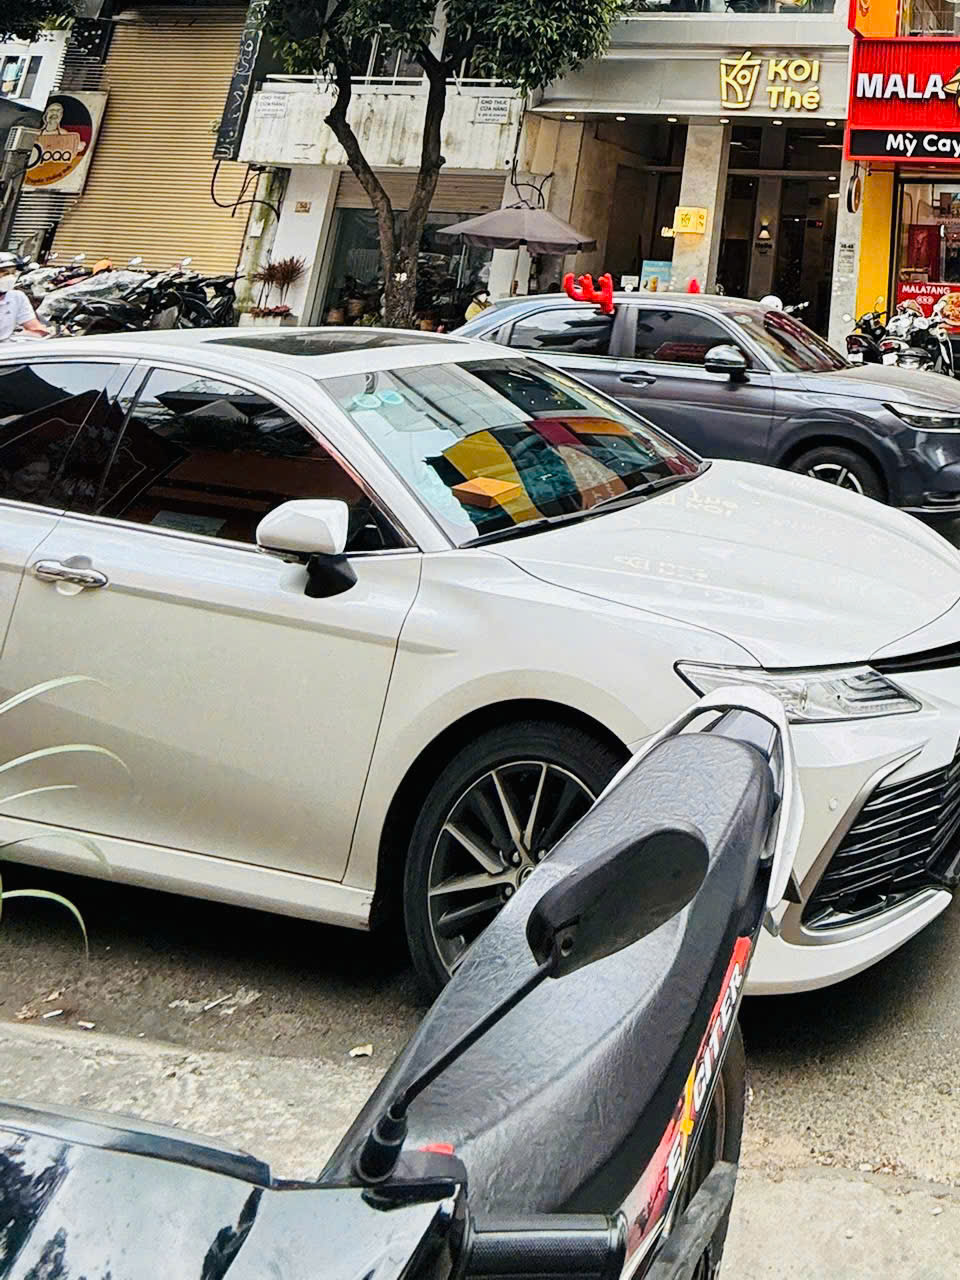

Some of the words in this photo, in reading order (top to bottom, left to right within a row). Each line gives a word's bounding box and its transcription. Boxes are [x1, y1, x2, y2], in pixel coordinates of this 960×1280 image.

[767, 59, 820, 82] KOI
[766, 86, 820, 110] Thé
[856, 73, 946, 100] MALA
[886, 133, 917, 157] Mỳ
[901, 284, 950, 296] MALATANG
[667, 961, 743, 1192] EXCITER
